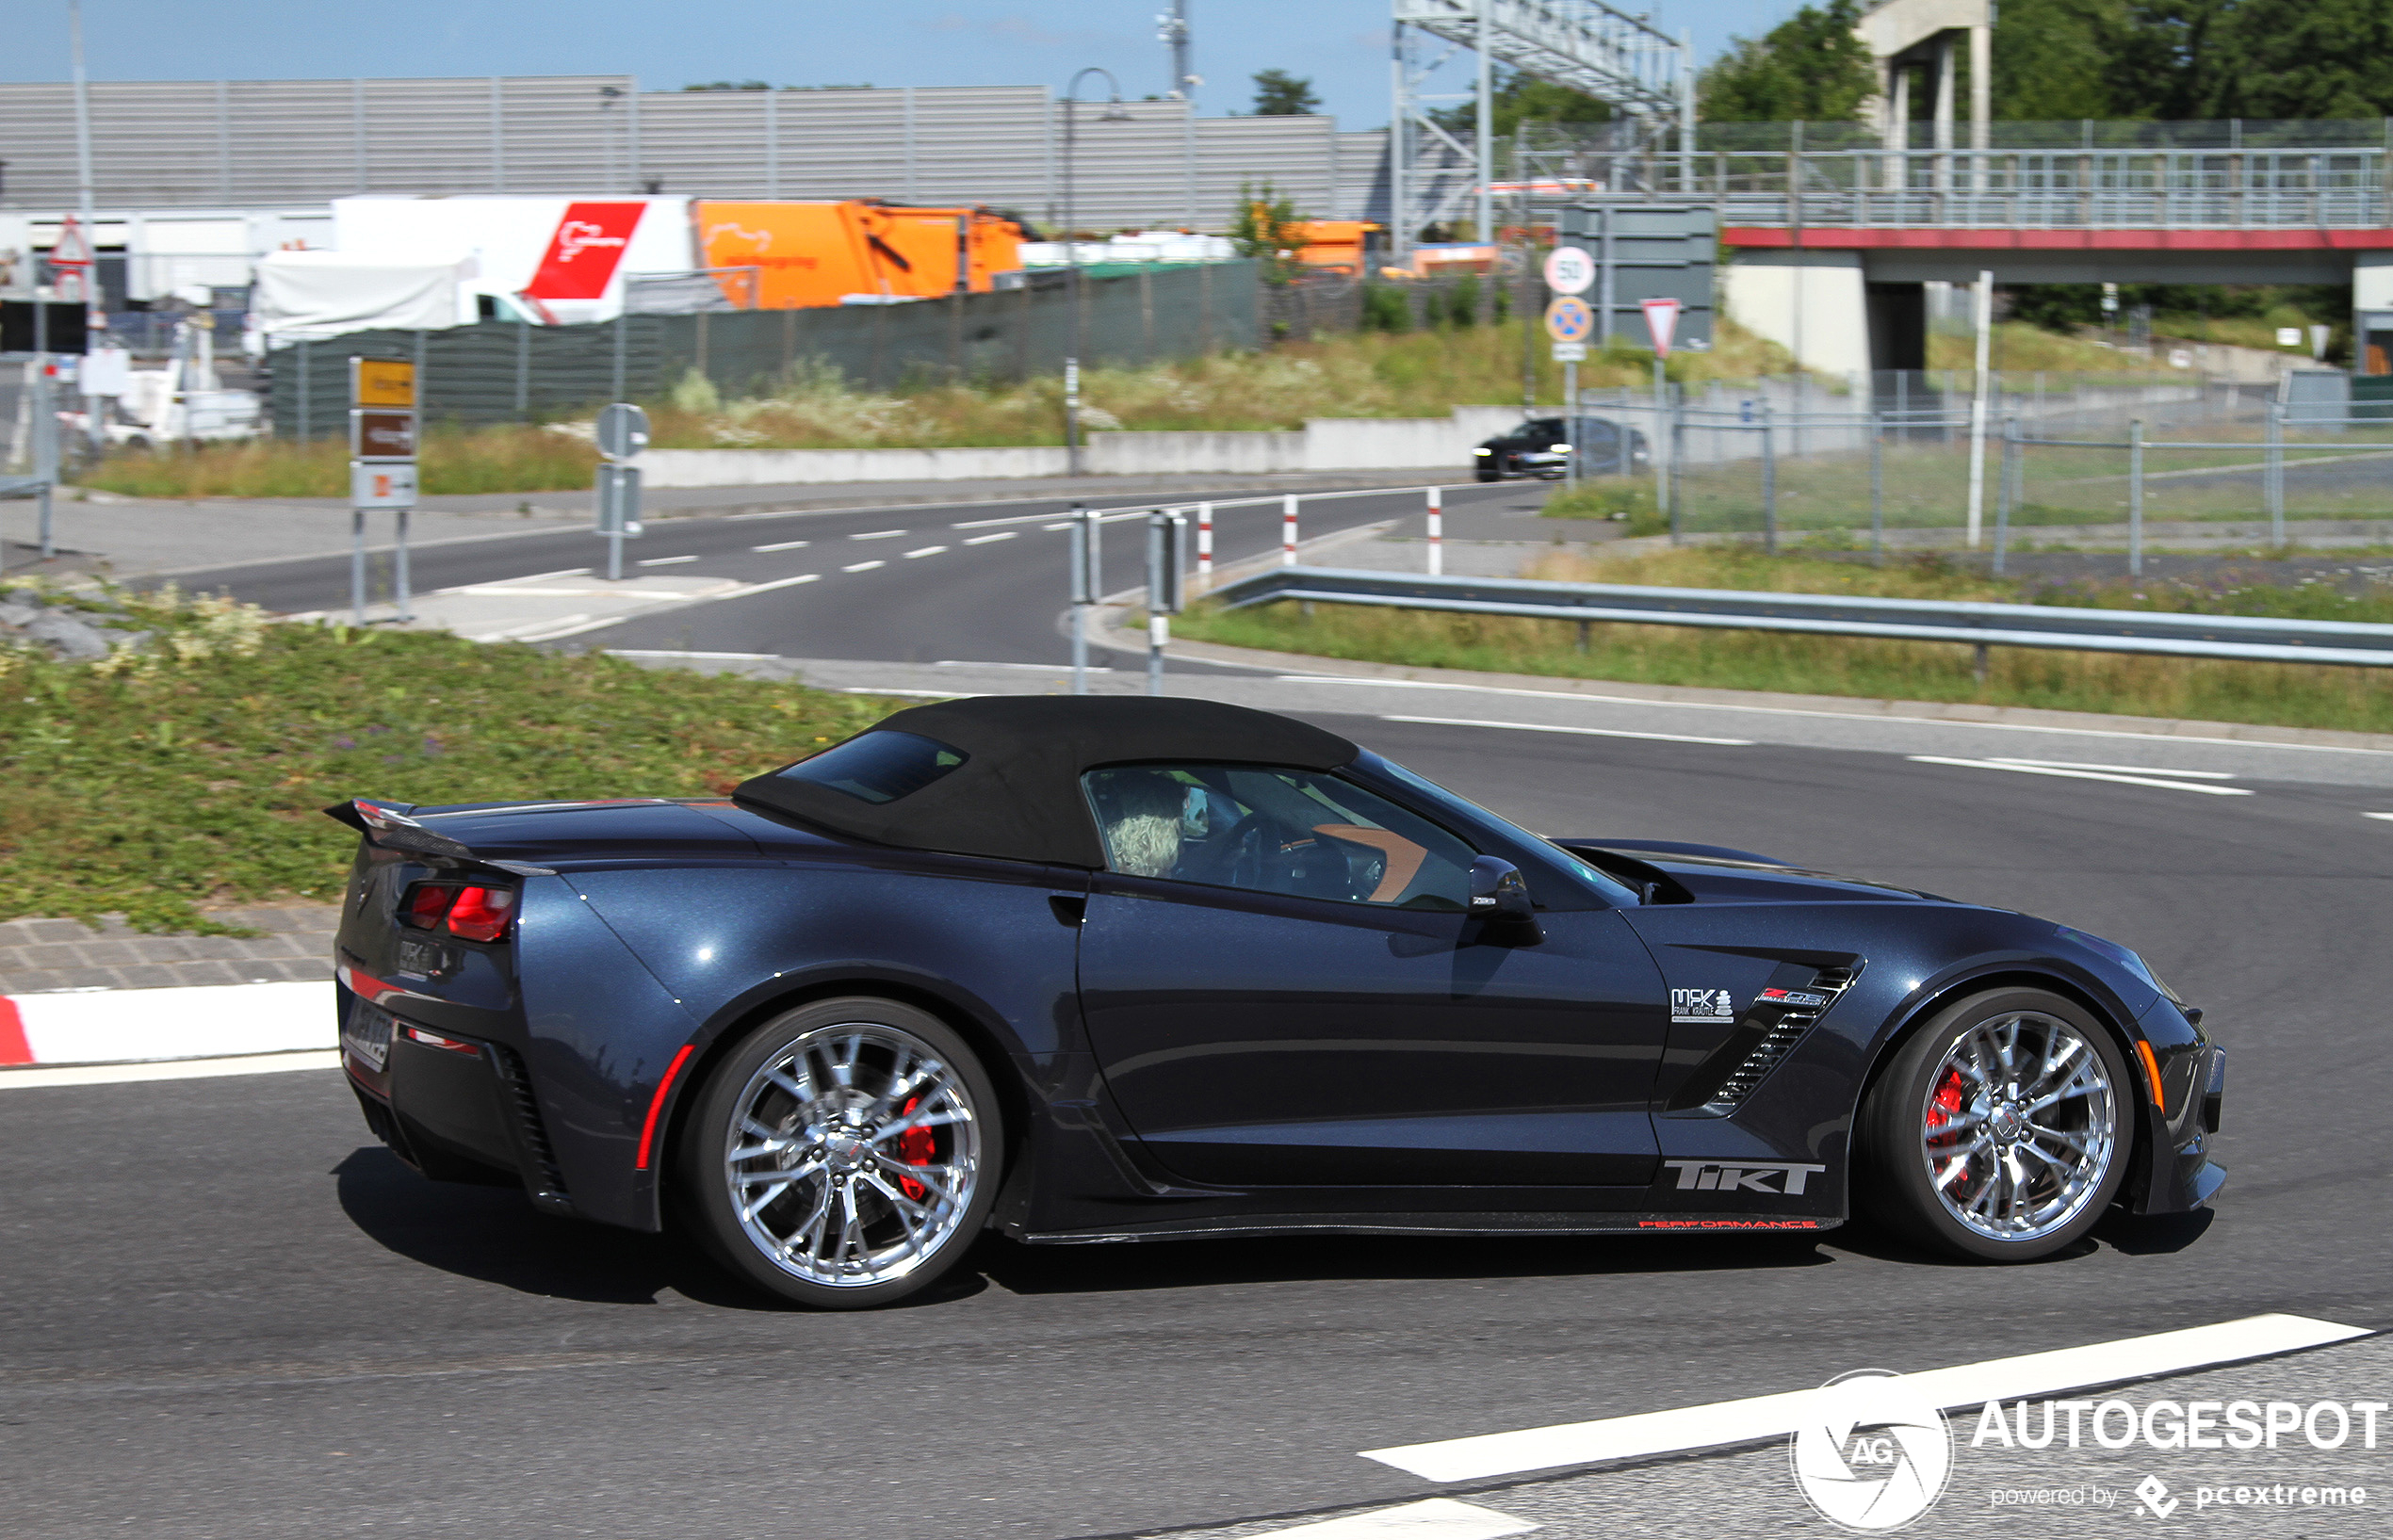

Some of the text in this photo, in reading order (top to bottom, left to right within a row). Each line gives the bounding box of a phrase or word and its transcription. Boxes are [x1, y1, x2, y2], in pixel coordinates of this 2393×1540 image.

[1557, 260, 1581, 280] 50
[1671, 989, 1716, 1009] MFK
[1674, 1007, 1690, 1015] FRANK
